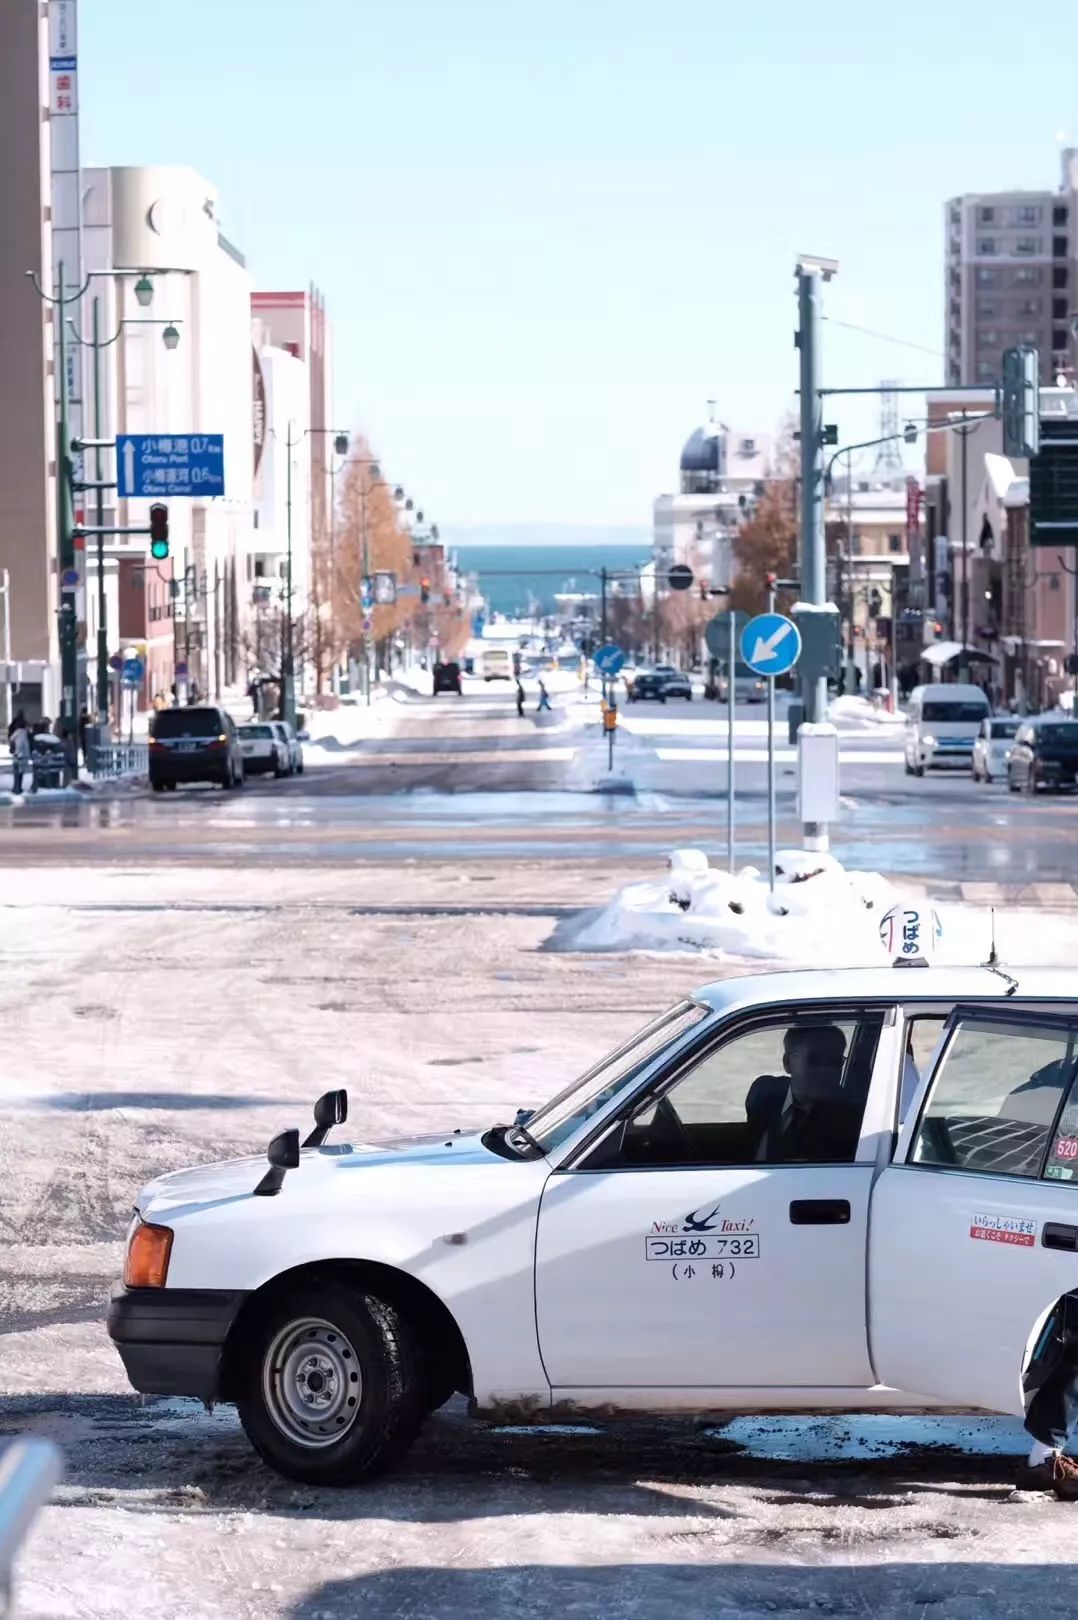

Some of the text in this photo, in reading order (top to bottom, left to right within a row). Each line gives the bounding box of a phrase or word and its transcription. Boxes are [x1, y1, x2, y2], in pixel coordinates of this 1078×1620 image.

[902, 910, 920, 954] つばめ
[1057, 1140, 1078, 1157] 520
[650, 1219, 754, 1233] Nice Taxi!
[650, 1239, 754, 1256] つばめ 732
